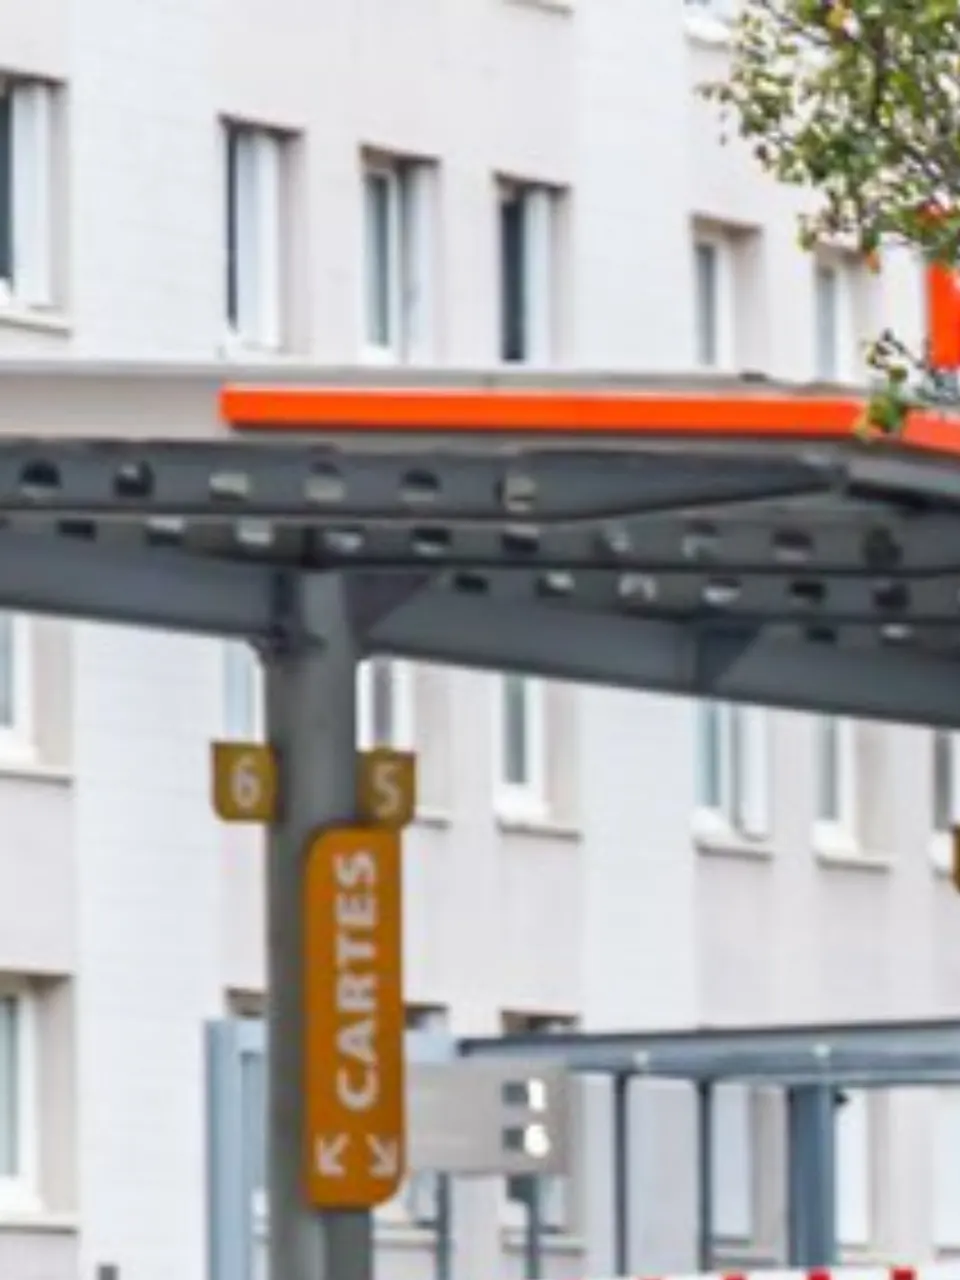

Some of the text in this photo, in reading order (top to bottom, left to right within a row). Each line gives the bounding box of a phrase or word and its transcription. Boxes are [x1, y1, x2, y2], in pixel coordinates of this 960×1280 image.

[229, 754, 261, 810] 6
[371, 762, 403, 818] 5
[333, 851, 378, 1112] CARTES
